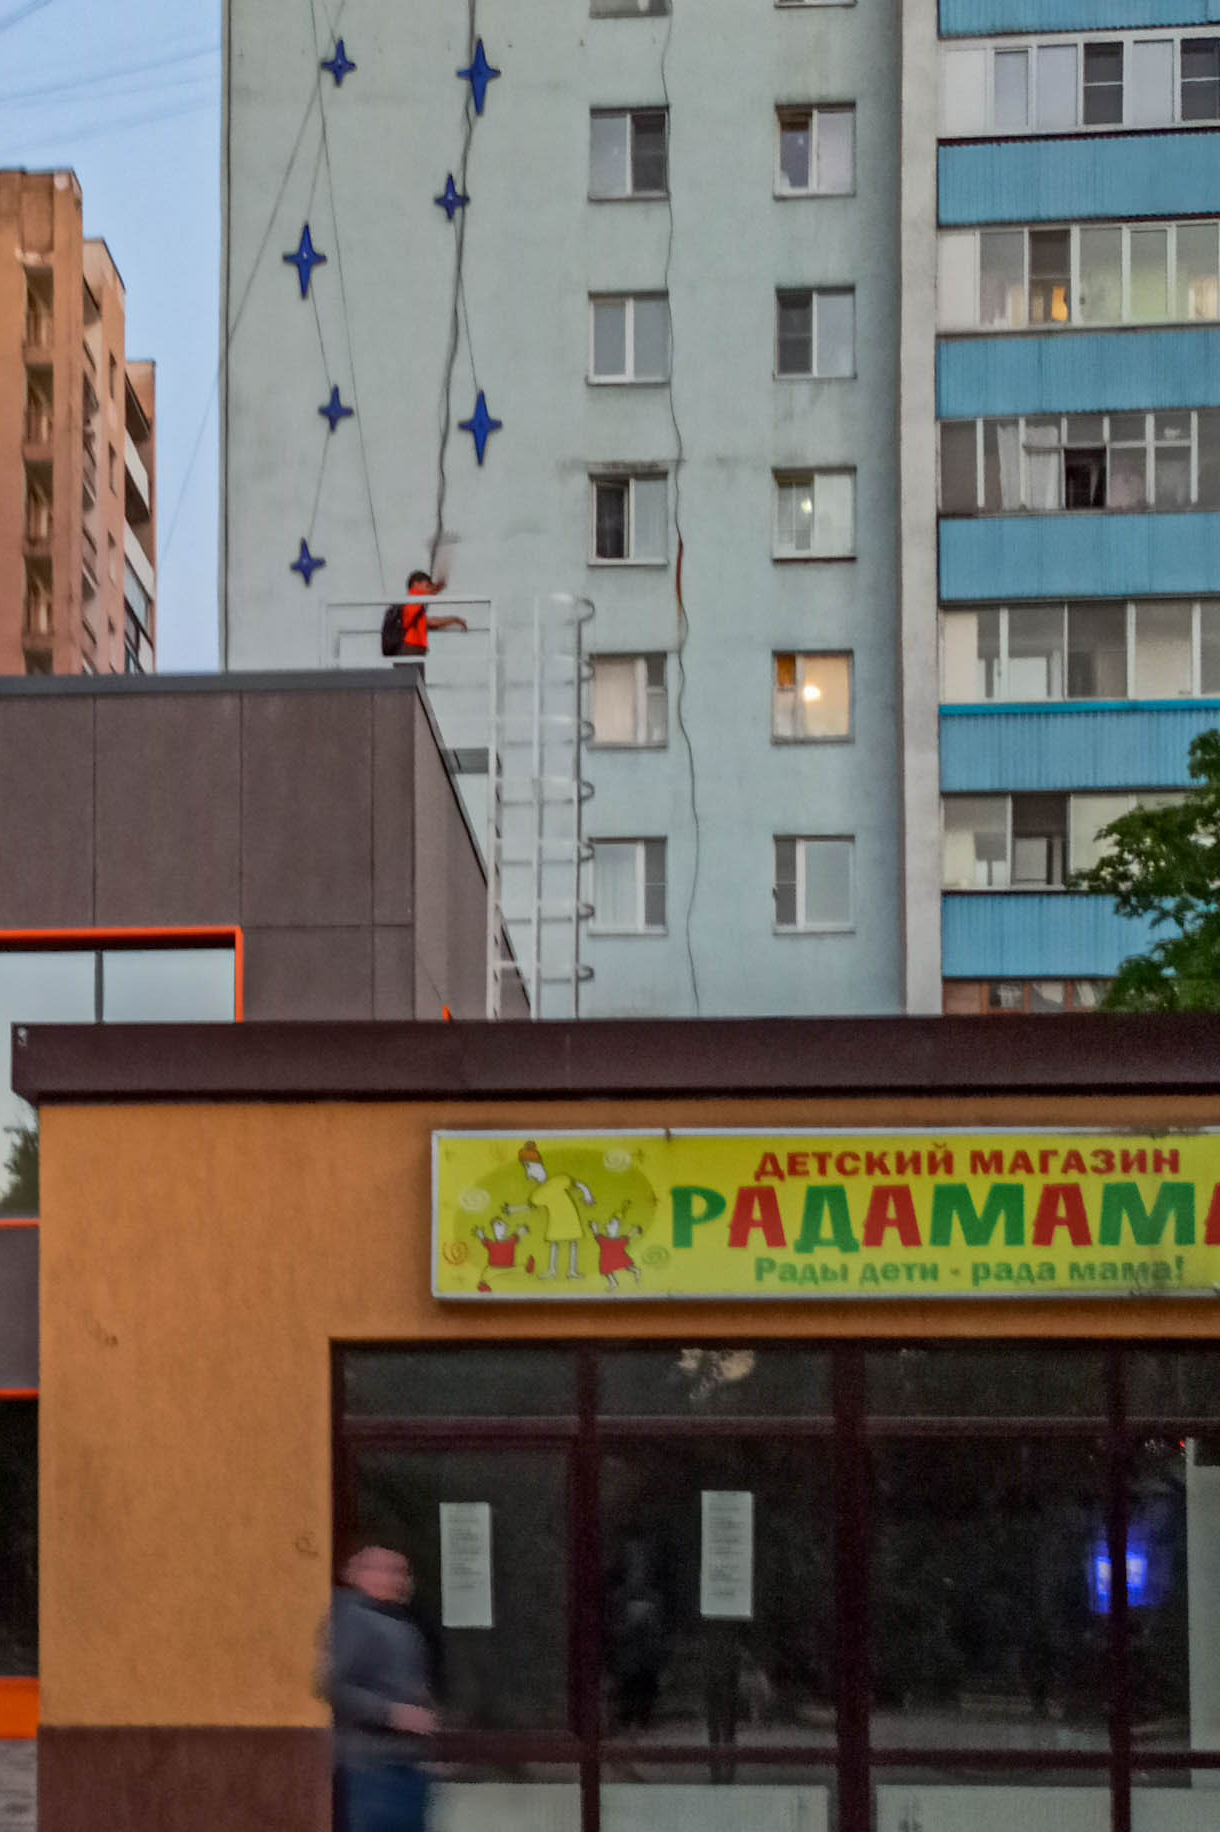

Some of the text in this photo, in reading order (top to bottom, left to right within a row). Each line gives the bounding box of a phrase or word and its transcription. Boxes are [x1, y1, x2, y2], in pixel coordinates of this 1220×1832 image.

[754, 1143, 1180, 1182] ДЕТСКИЙ МАГАЗИН
[670, 1182, 1220, 1254] РАДАМАМ
[754, 1257, 849, 1285] Рады
[858, 1262, 940, 1285] дети
[971, 1261, 1056, 1287] рада
[1069, 1255, 1184, 1281] мама!
